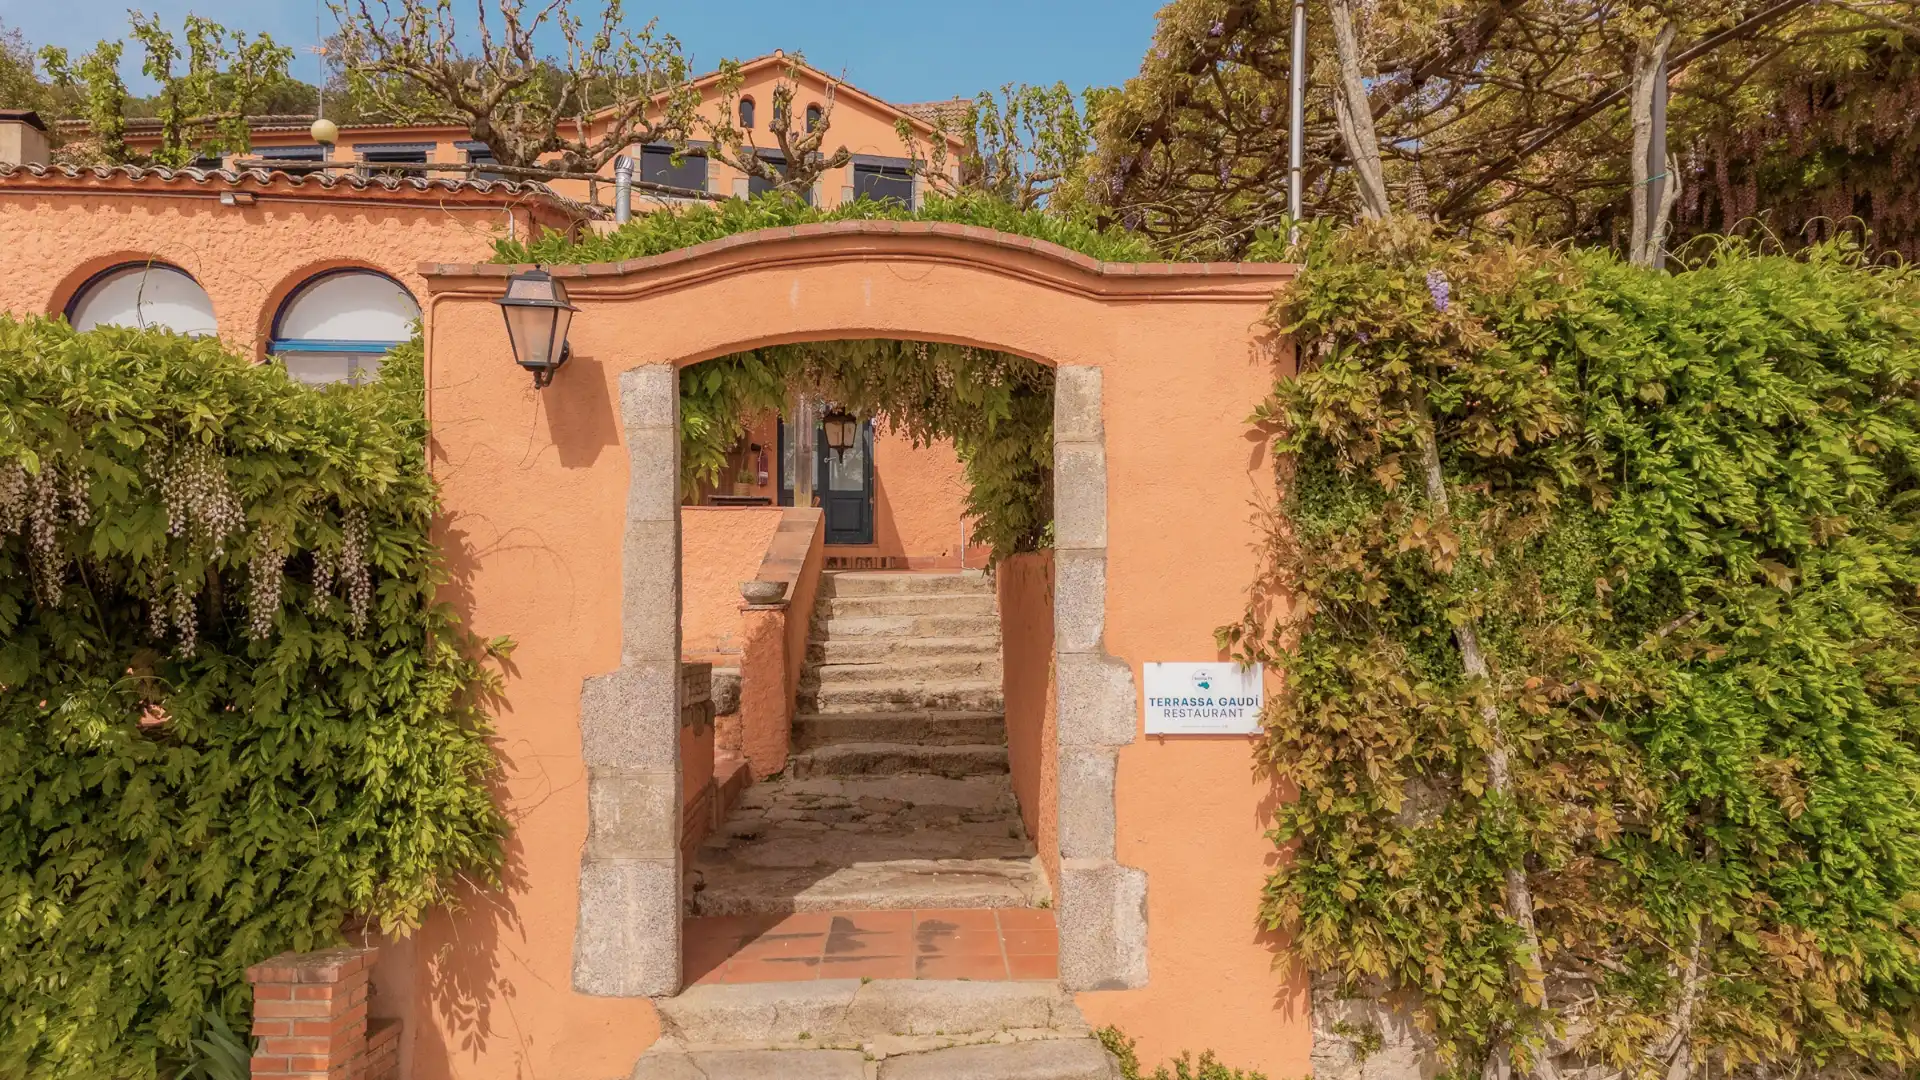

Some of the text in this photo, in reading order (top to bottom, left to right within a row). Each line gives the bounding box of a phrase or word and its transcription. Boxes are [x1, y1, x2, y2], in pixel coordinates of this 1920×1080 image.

[1149, 695, 1258, 707] TERRASSA GAUDÍ
[1164, 708, 1244, 718] RESTAURANT
